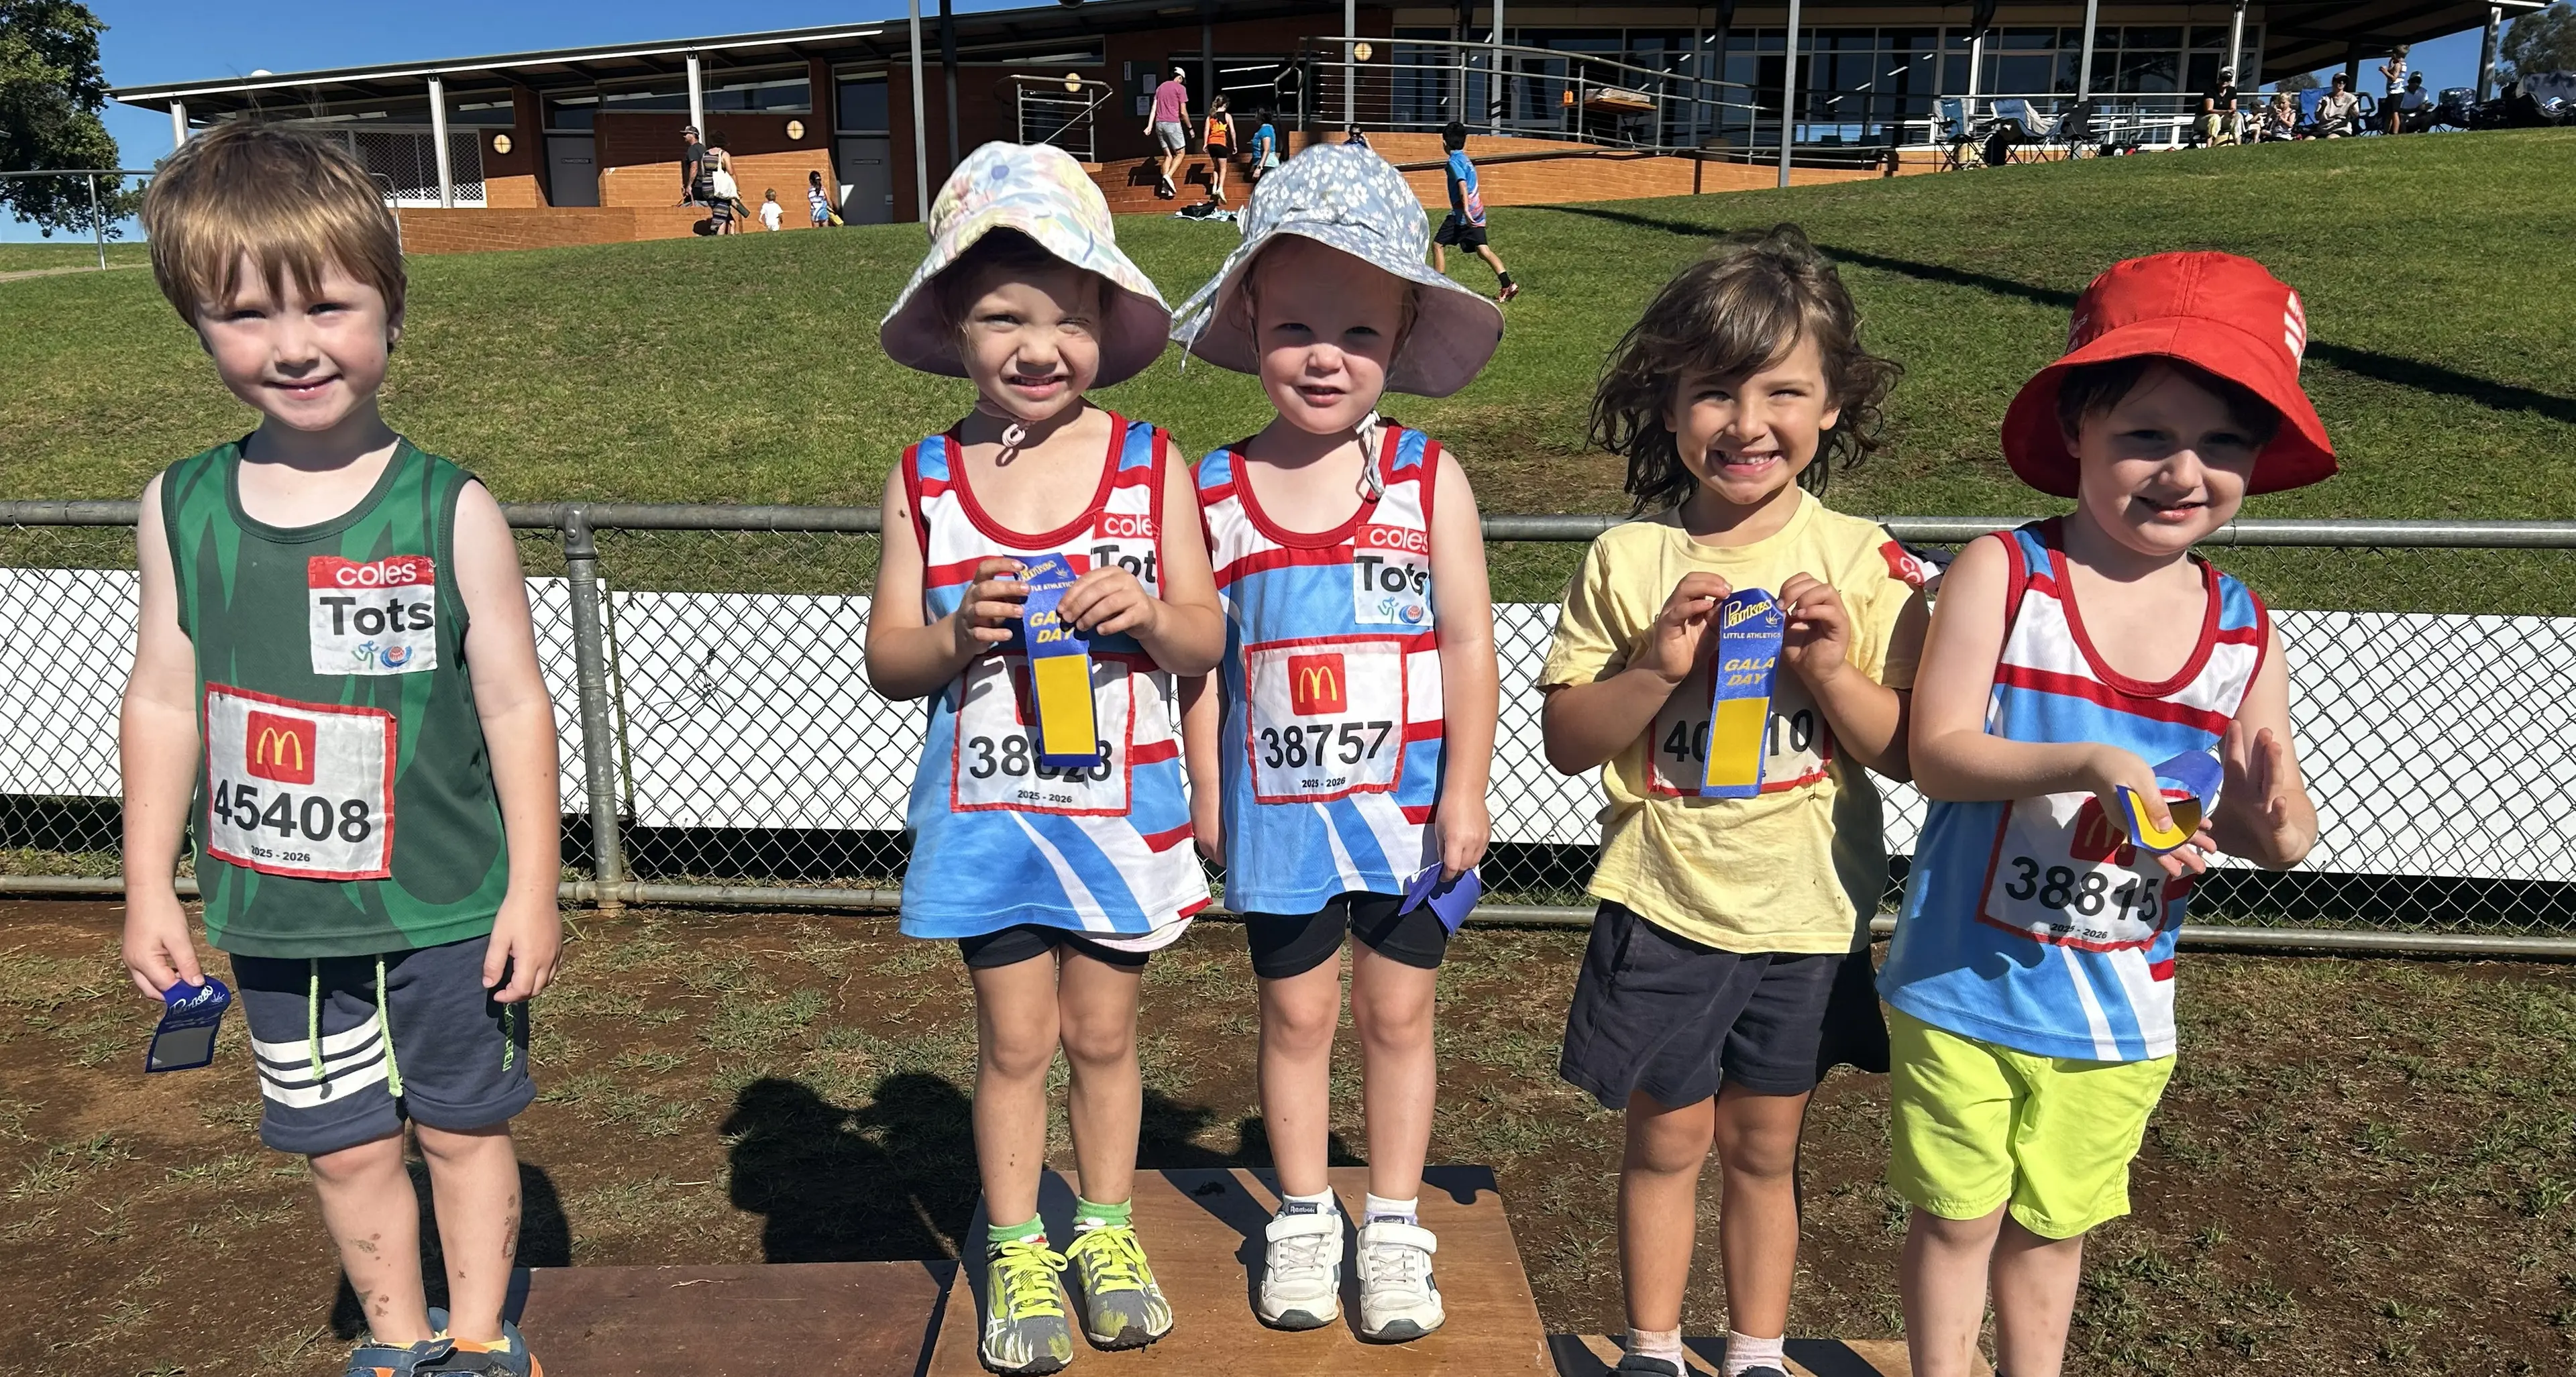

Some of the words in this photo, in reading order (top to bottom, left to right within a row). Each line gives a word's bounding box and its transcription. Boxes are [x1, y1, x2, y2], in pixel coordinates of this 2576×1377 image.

[1104, 514, 1153, 537] cole
[1370, 527, 1428, 553] coles
[336, 561, 417, 586] coles
[1091, 545, 1156, 583] Tot
[1043, 581, 1075, 590] ATHLETIC
[320, 597, 435, 635] Tots
[1030, 611, 1061, 628] GA
[1725, 657, 1776, 672] GALA
[1727, 672, 1769, 686] DAY
[1260, 720, 1393, 769] 38757
[1664, 709, 1814, 763] 4010
[1301, 779, 1320, 788] 2025
[1326, 777, 1346, 787] 2026
[1017, 789, 1040, 800] 2025
[1049, 794, 1073, 803] 2026
[214, 779, 371, 843] 45408
[251, 845, 273, 858] 2025
[282, 851, 311, 862] 2026
[2005, 856, 2157, 922] 38815
[2051, 923, 2075, 932] 2025
[2082, 928, 2108, 939] 2026
[1290, 1205, 1315, 1214] Reebok
